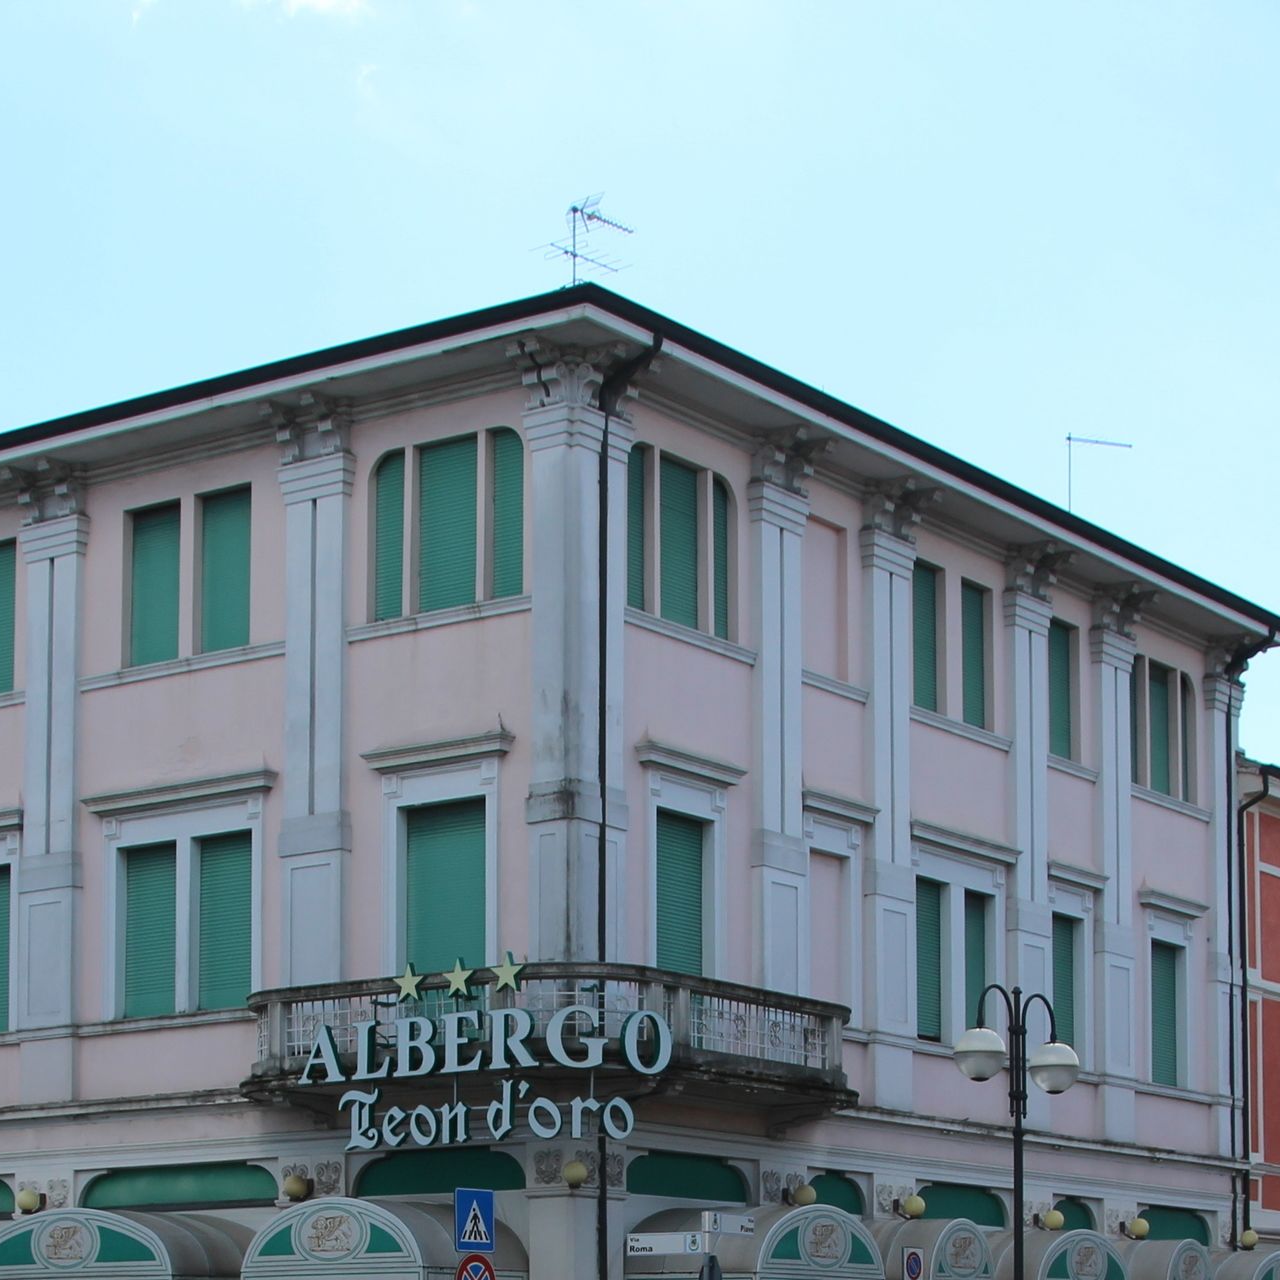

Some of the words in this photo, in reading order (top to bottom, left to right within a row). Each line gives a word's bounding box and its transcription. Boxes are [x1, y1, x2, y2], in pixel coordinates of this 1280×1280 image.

[298, 1004, 673, 1085] ALBERGO
[339, 1087, 469, 1151] Leon
[486, 1079, 635, 1141] d'oro
[629, 1245, 653, 1253] Roma
